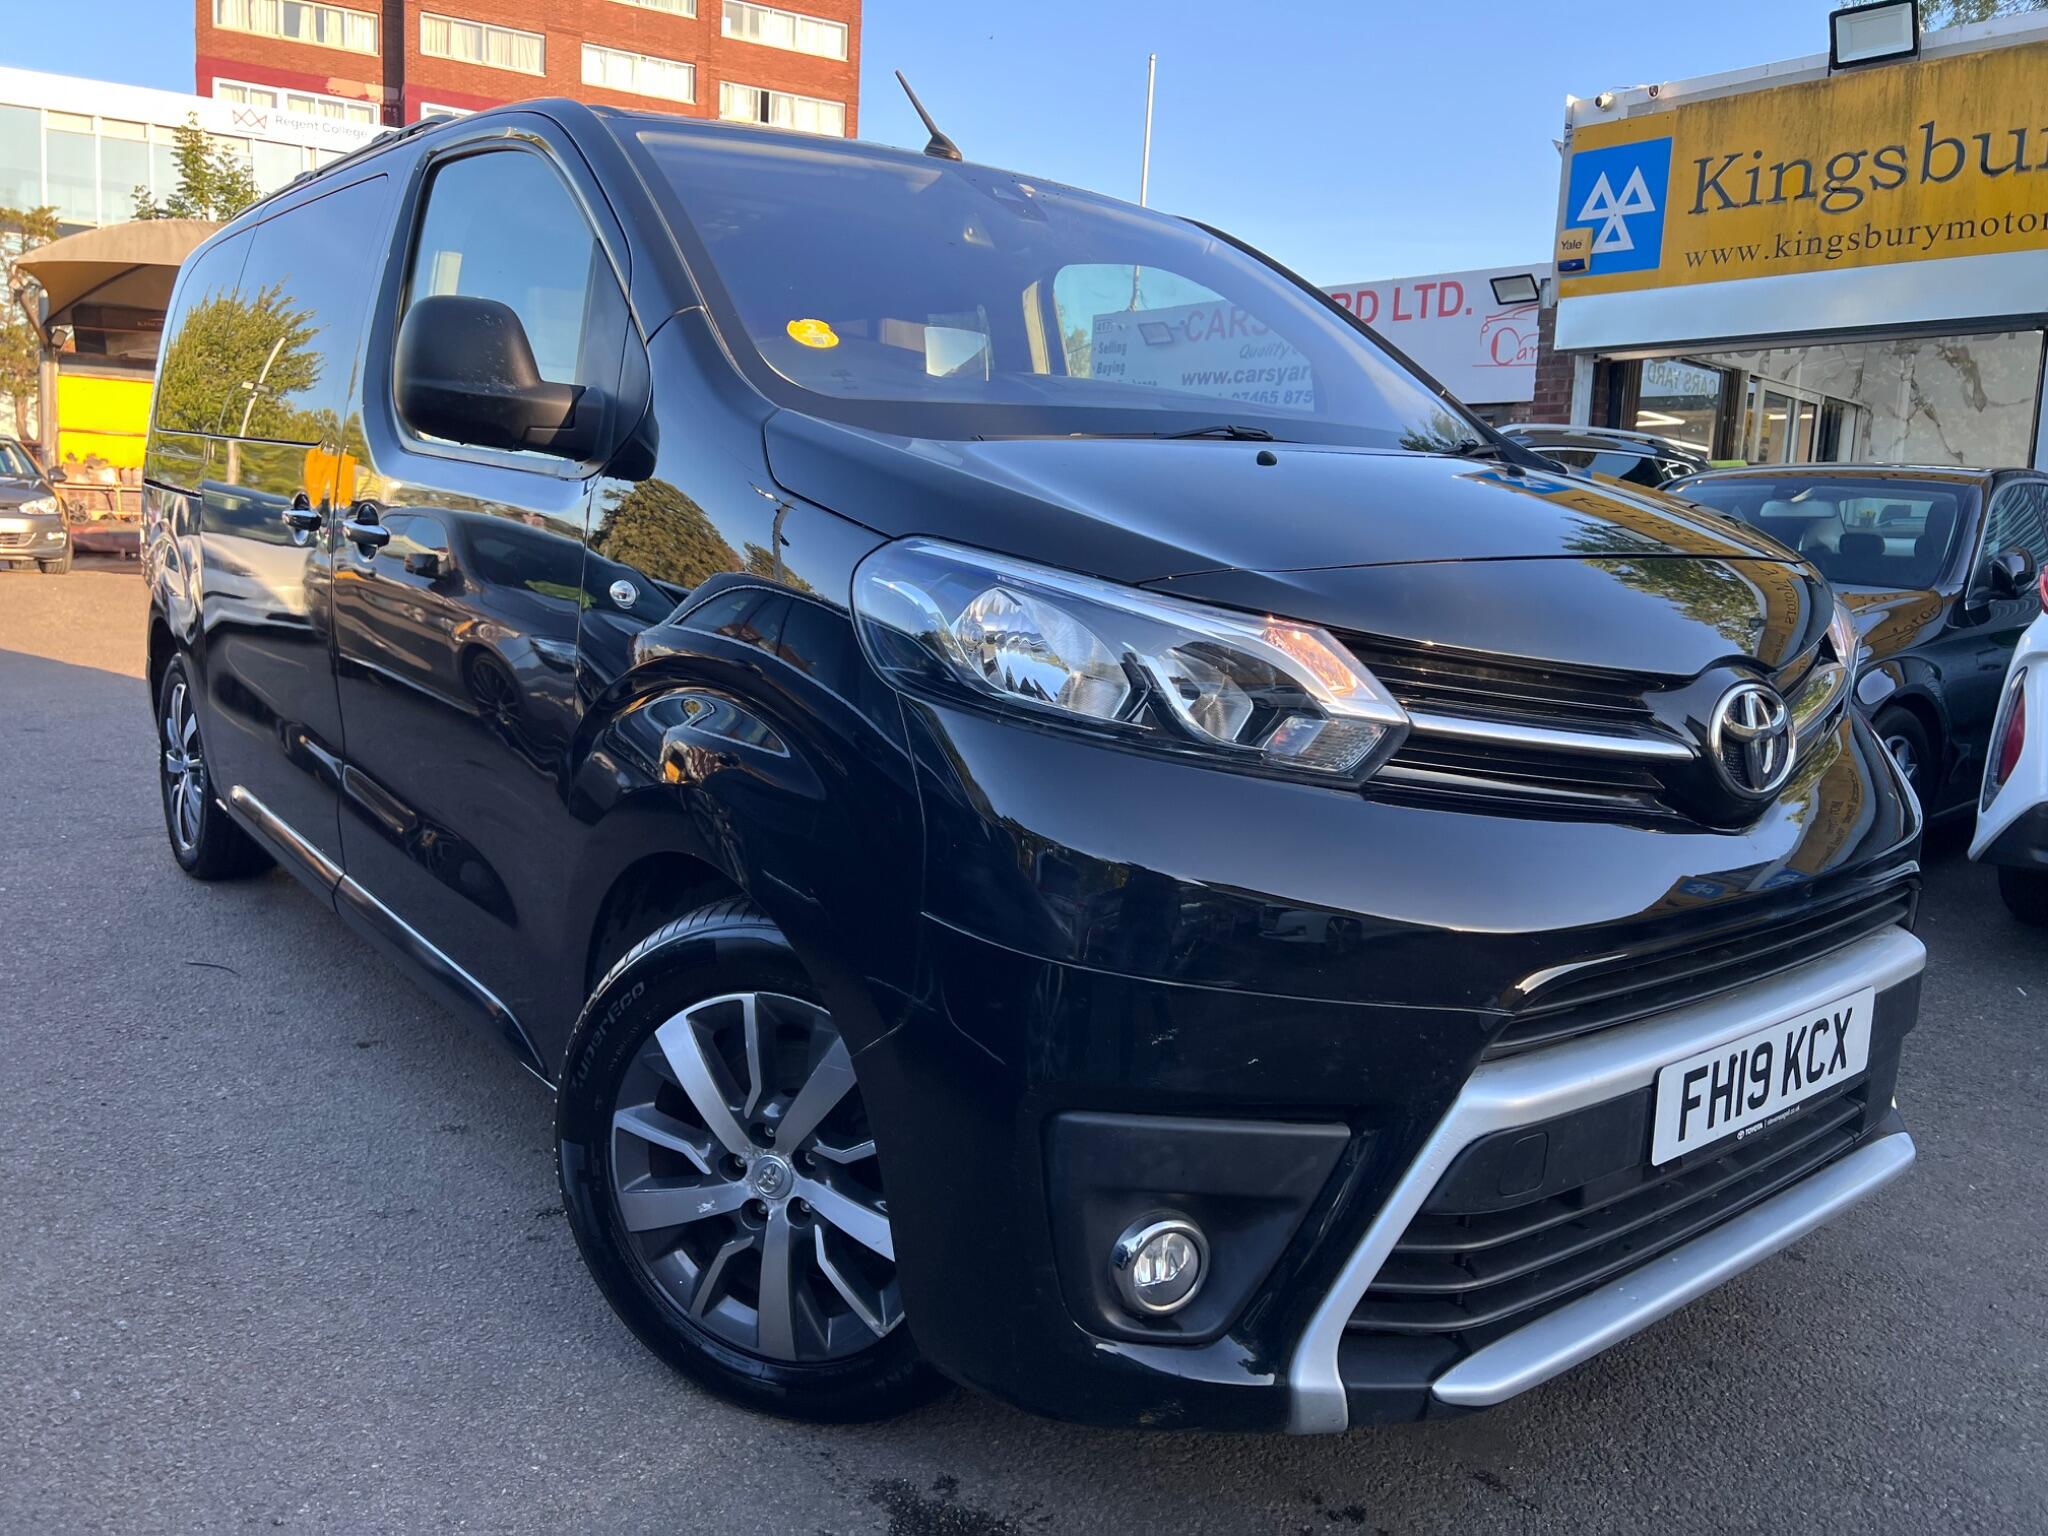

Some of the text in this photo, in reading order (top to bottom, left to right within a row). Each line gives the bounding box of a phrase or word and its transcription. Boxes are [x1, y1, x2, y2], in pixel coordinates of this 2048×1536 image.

[275, 115, 368, 138] Regent College
[1561, 239, 1583, 250] Yale
[1392, 279, 1473, 322] LTD.
[1098, 341, 1128, 356] Selling
[1096, 361, 1126, 377] Buying
[1677, 1006, 1853, 1143] FH19 KCX
